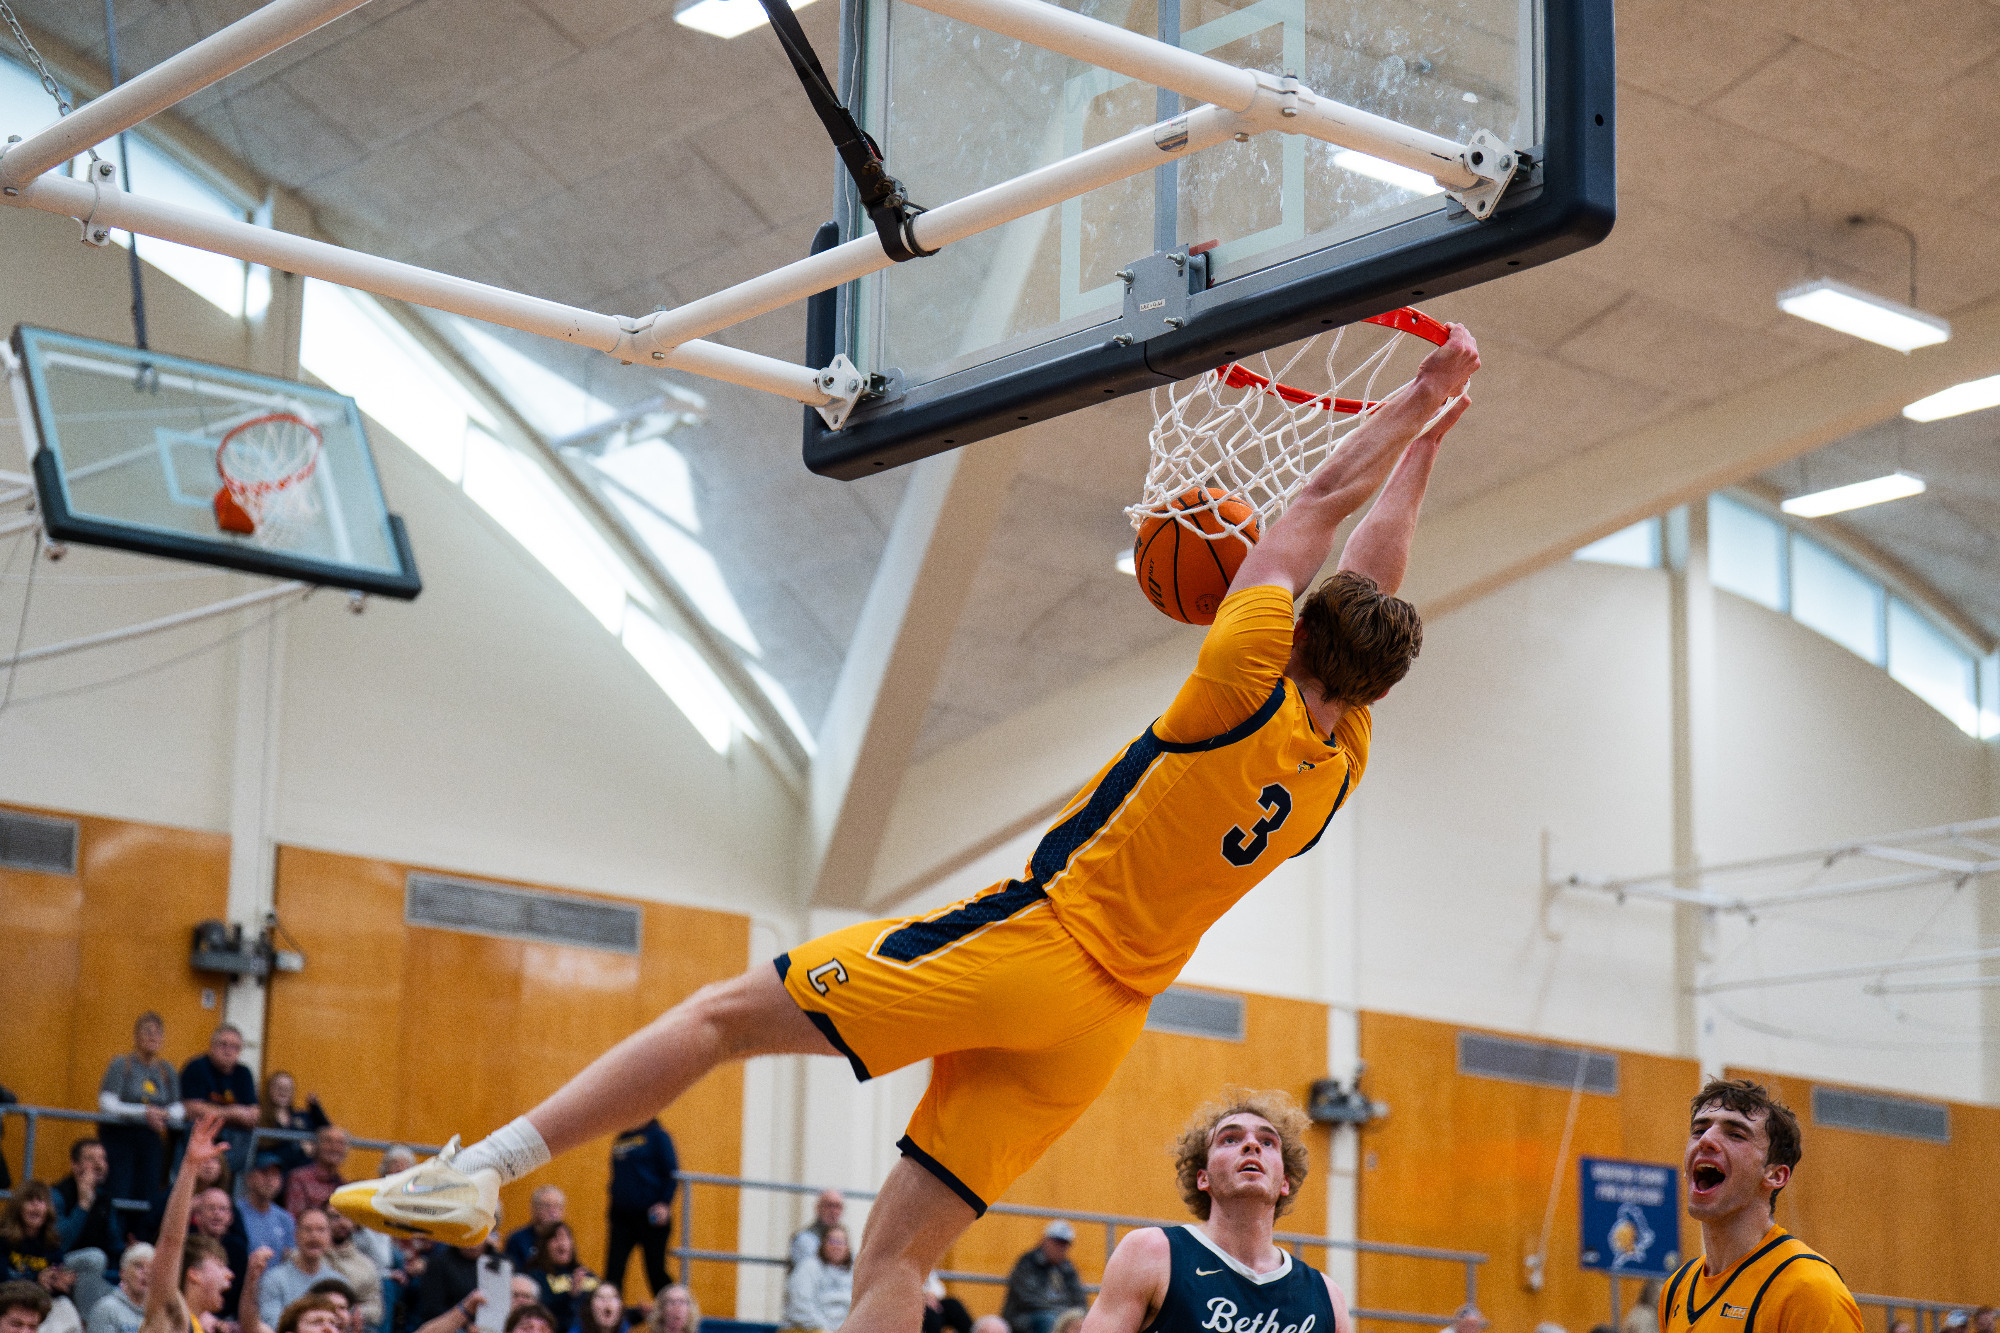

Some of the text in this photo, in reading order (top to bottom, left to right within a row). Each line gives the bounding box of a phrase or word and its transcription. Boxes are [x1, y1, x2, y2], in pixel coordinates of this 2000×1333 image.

[1220, 781, 1293, 868] 3
[806, 957, 849, 997] C
[1201, 1296, 1316, 1333] Bethel
